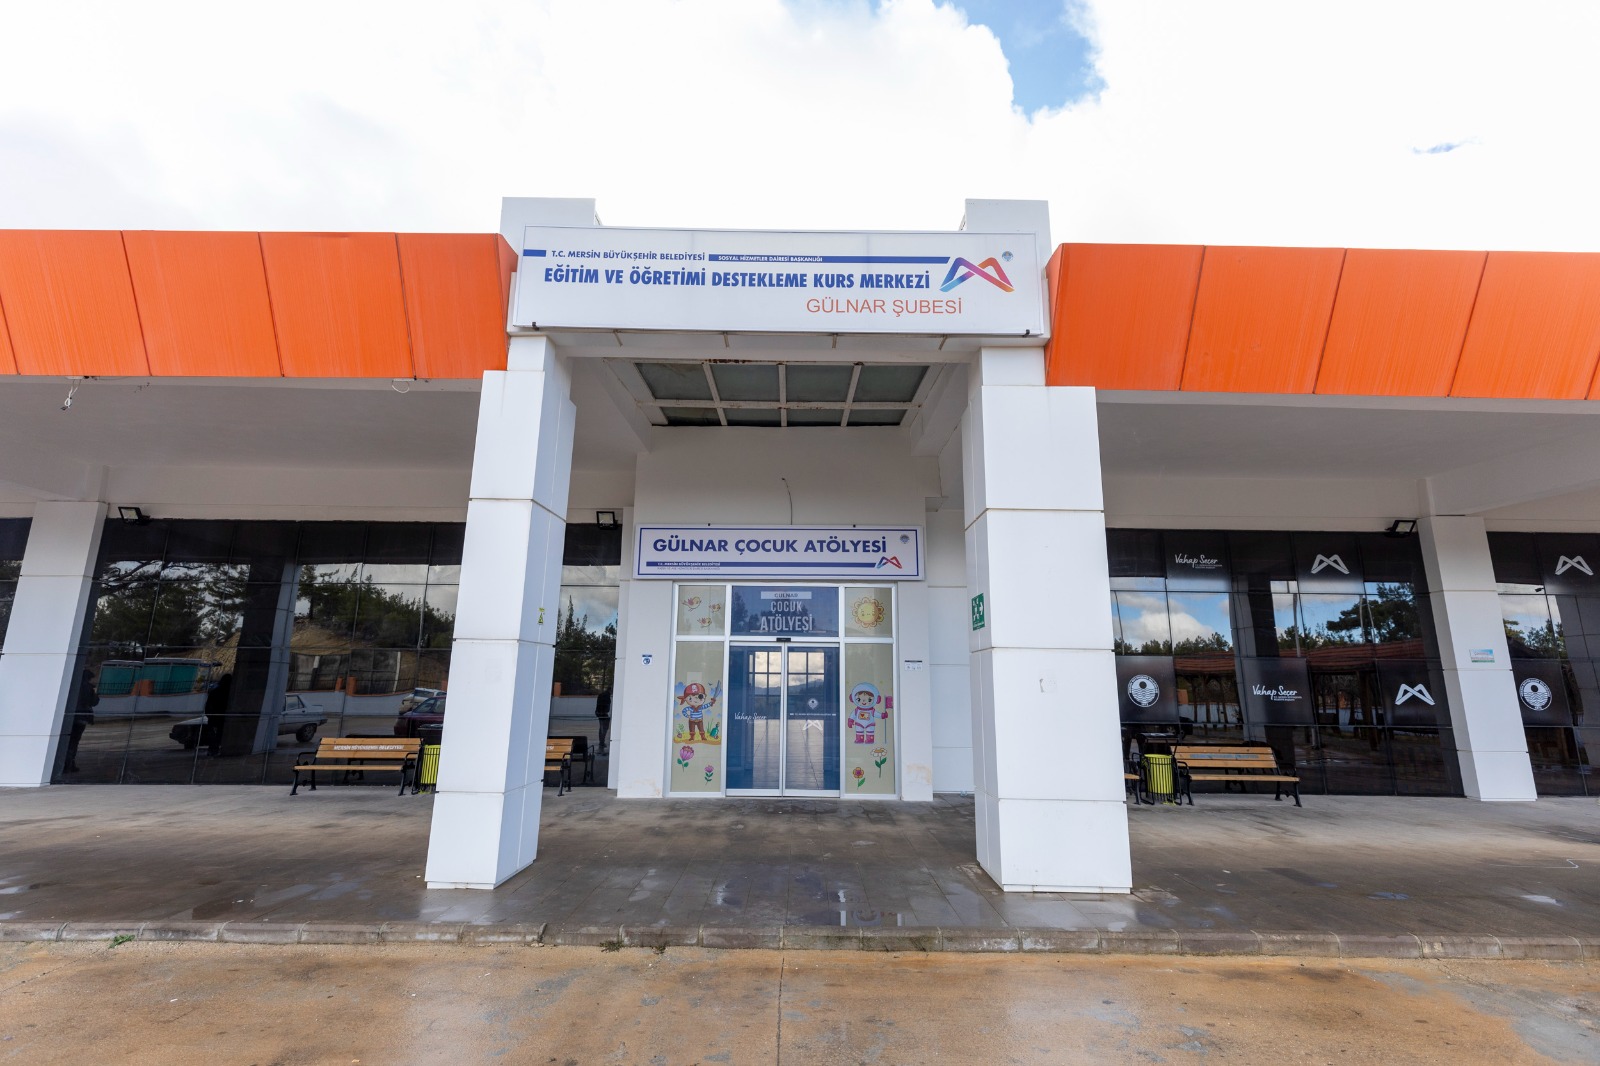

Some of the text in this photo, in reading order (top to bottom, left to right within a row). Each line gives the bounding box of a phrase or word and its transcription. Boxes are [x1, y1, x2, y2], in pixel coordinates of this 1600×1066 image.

[551, 249, 706, 262] T.C. MERSİN BÜYÜKŞEHİR BELEDİYESİ
[544, 264, 930, 290] EĞİTİM VE ÖĞRETİMİ DESTEKLEME KURS MERKEZİ
[806, 296, 962, 317] GÜLNAR ŞUBESİ
[653, 534, 887, 556] GÜLNAR ÇOCUK ATÖLYESİ
[1174, 552, 1199, 568] Vahap
[770, 601, 802, 614] ÇOCUK
[760, 613, 813, 631] ATÖLYESİ
[1252, 684, 1277, 700] Vahap
